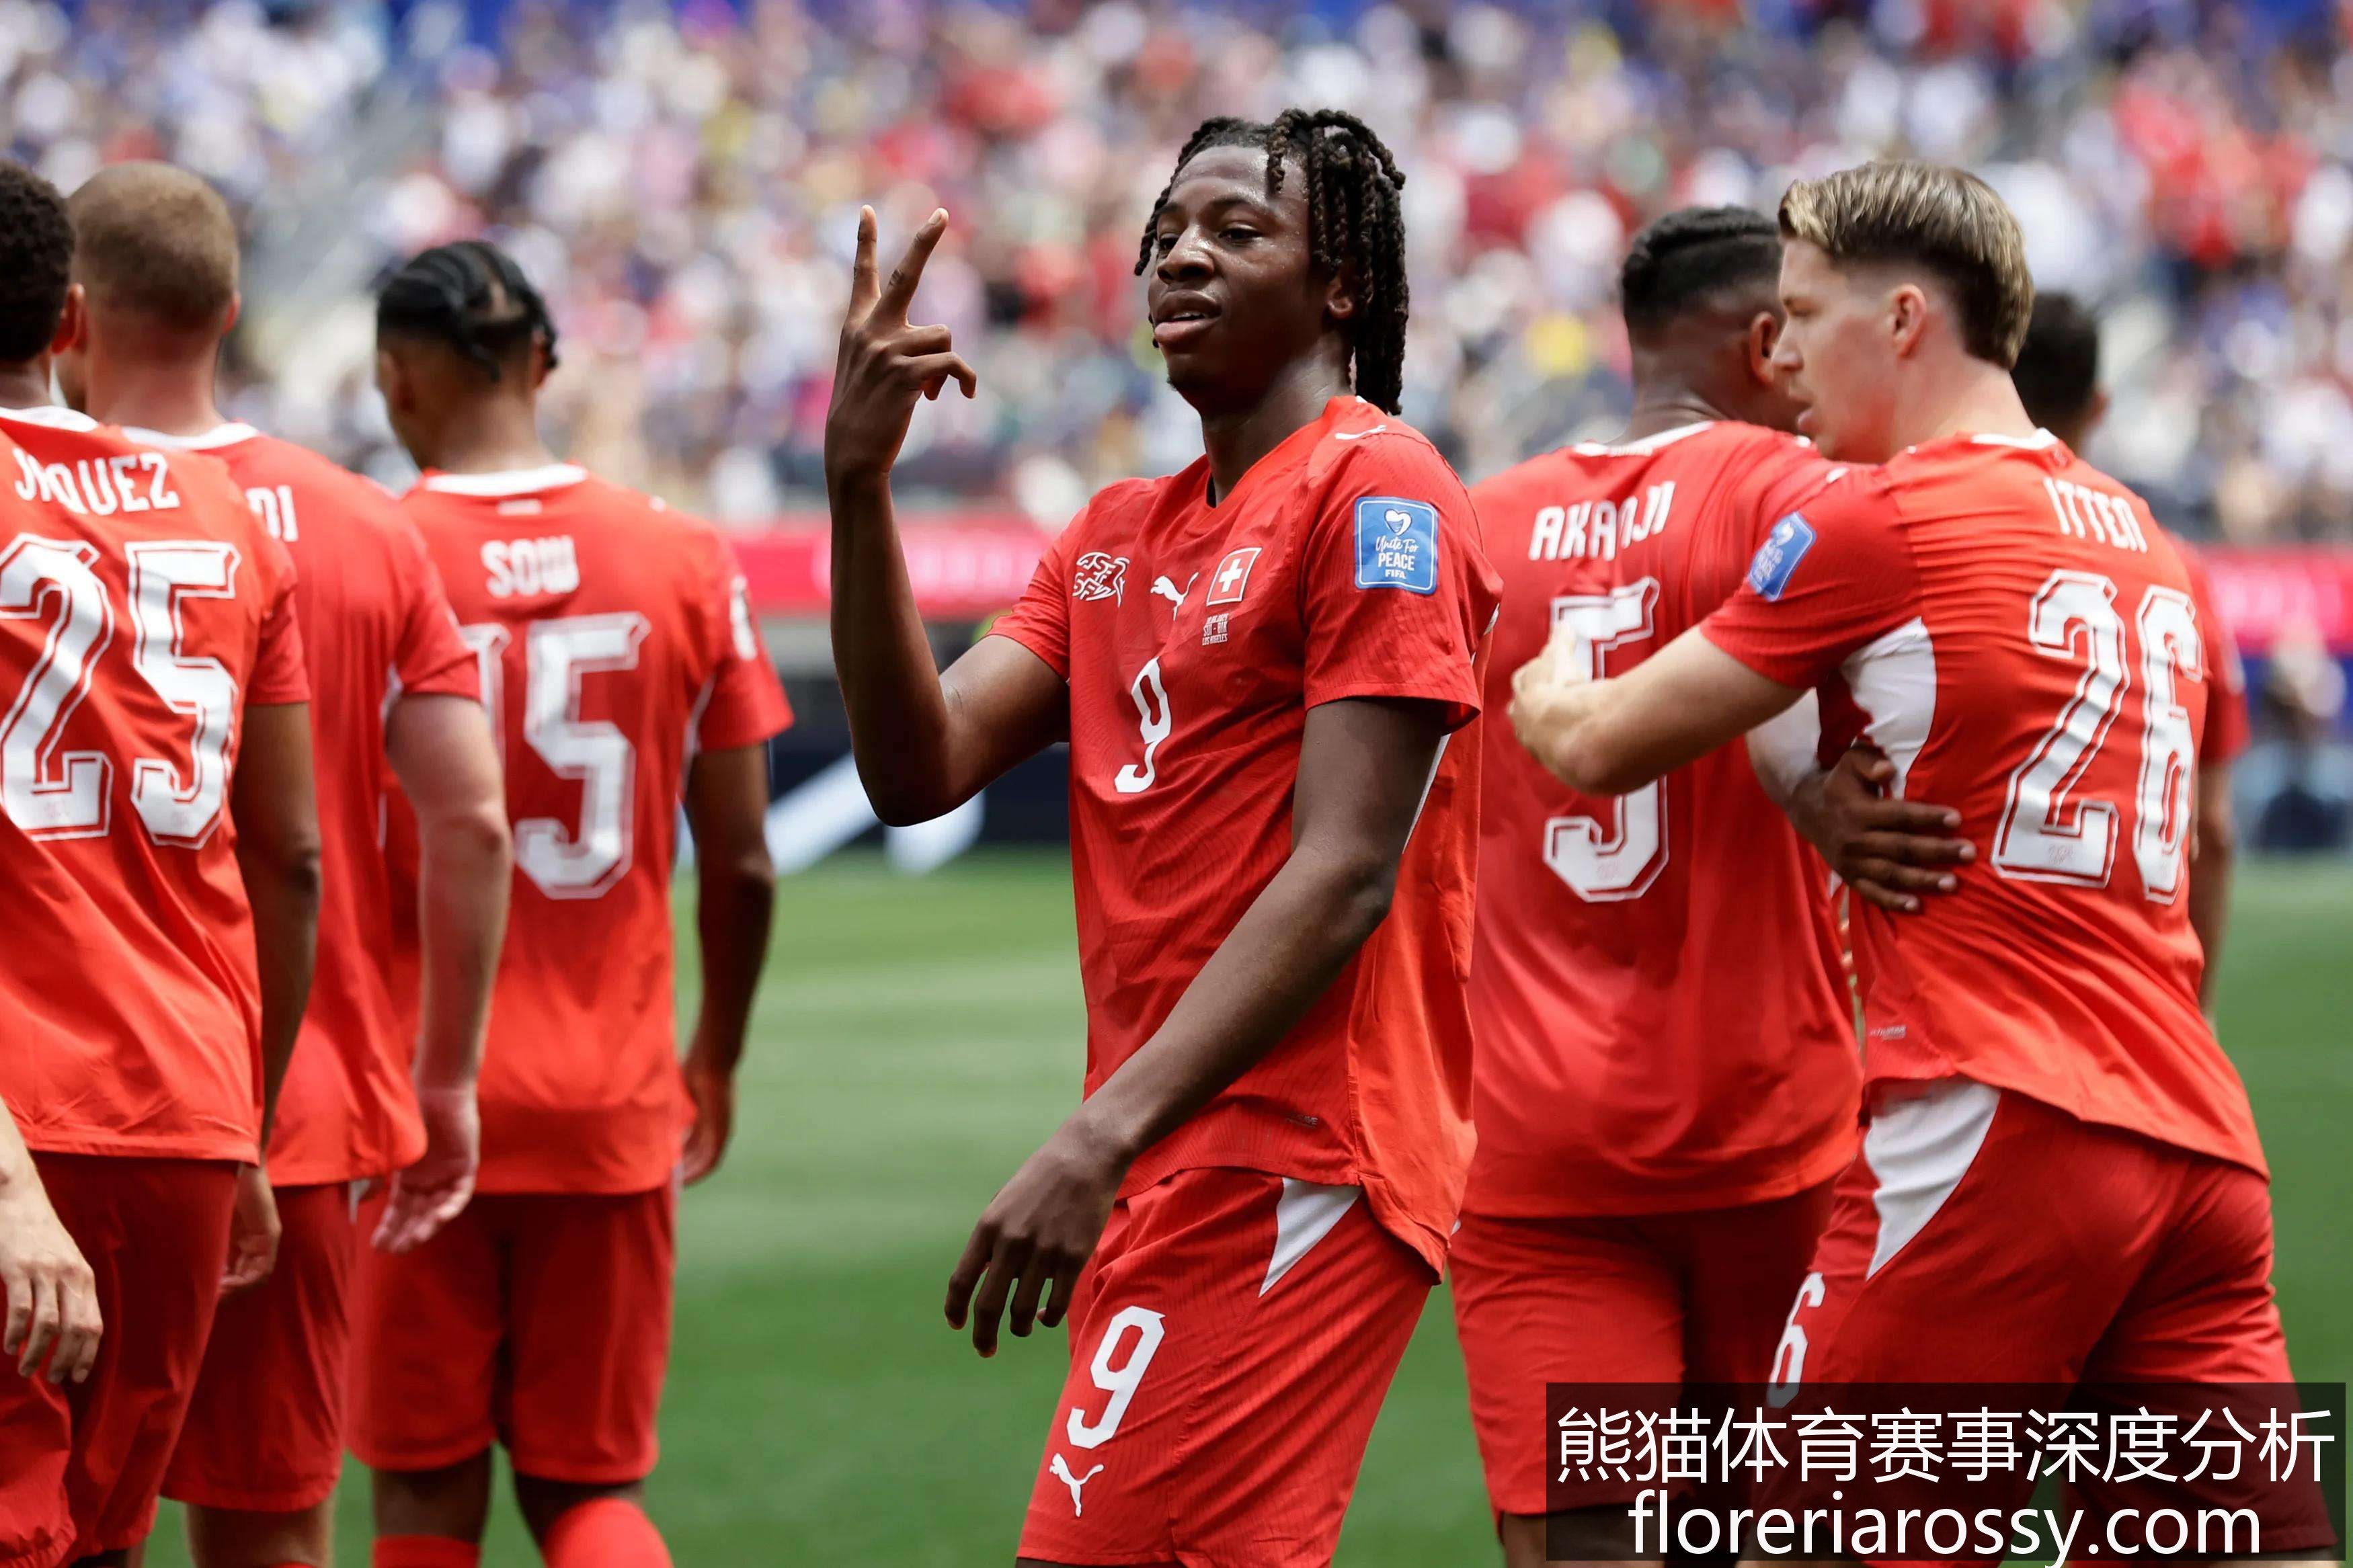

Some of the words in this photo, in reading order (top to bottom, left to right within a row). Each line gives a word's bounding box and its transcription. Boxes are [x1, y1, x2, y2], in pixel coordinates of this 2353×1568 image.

[481, 534, 580, 599] SOW
[1378, 551, 1416, 571] PEACE
[1528, 481, 1676, 562] AKANJI
[2042, 477, 2148, 554] ITTEN
[1385, 569, 1406, 579] FIFA
[0, 532, 241, 850] 25
[1115, 656, 1172, 794] 9
[1543, 576, 1669, 903] 5
[1991, 569, 2203, 905] 26
[1066, 1305, 1166, 1450] 9
